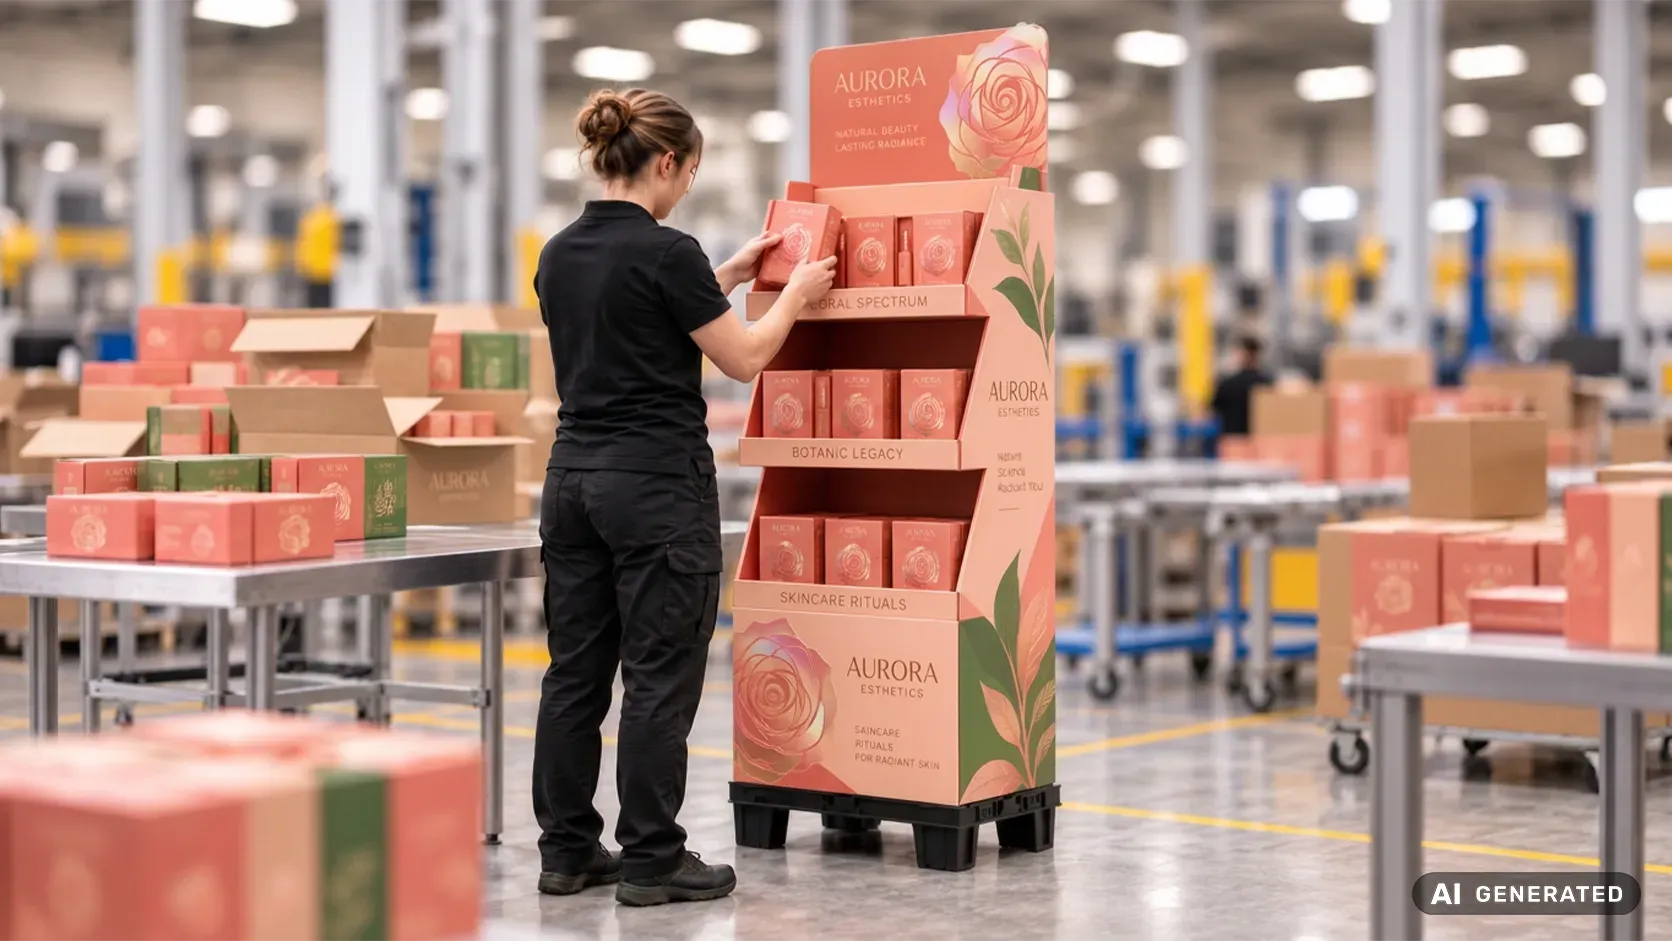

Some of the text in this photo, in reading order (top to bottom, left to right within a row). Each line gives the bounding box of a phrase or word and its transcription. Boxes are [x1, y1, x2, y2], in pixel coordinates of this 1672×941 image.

[834, 66, 927, 93] AURORA
[848, 94, 912, 108] ESTHETICS
[835, 124, 919, 139] NATURAL BEAUTY
[835, 140, 875, 152] LASTING
[857, 295, 928, 309] SPECTRUM
[989, 381, 1048, 402] AURORA
[792, 446, 904, 461] BOTANIC LEGACY
[780, 592, 907, 611] SKINCARE RITUALS
[846, 656, 939, 684] AURORA
[860, 684, 924, 698] ESTHETICS
[854, 739, 894, 752] RITUALS
[854, 753, 940, 770] FOR RADIANT SKIN
